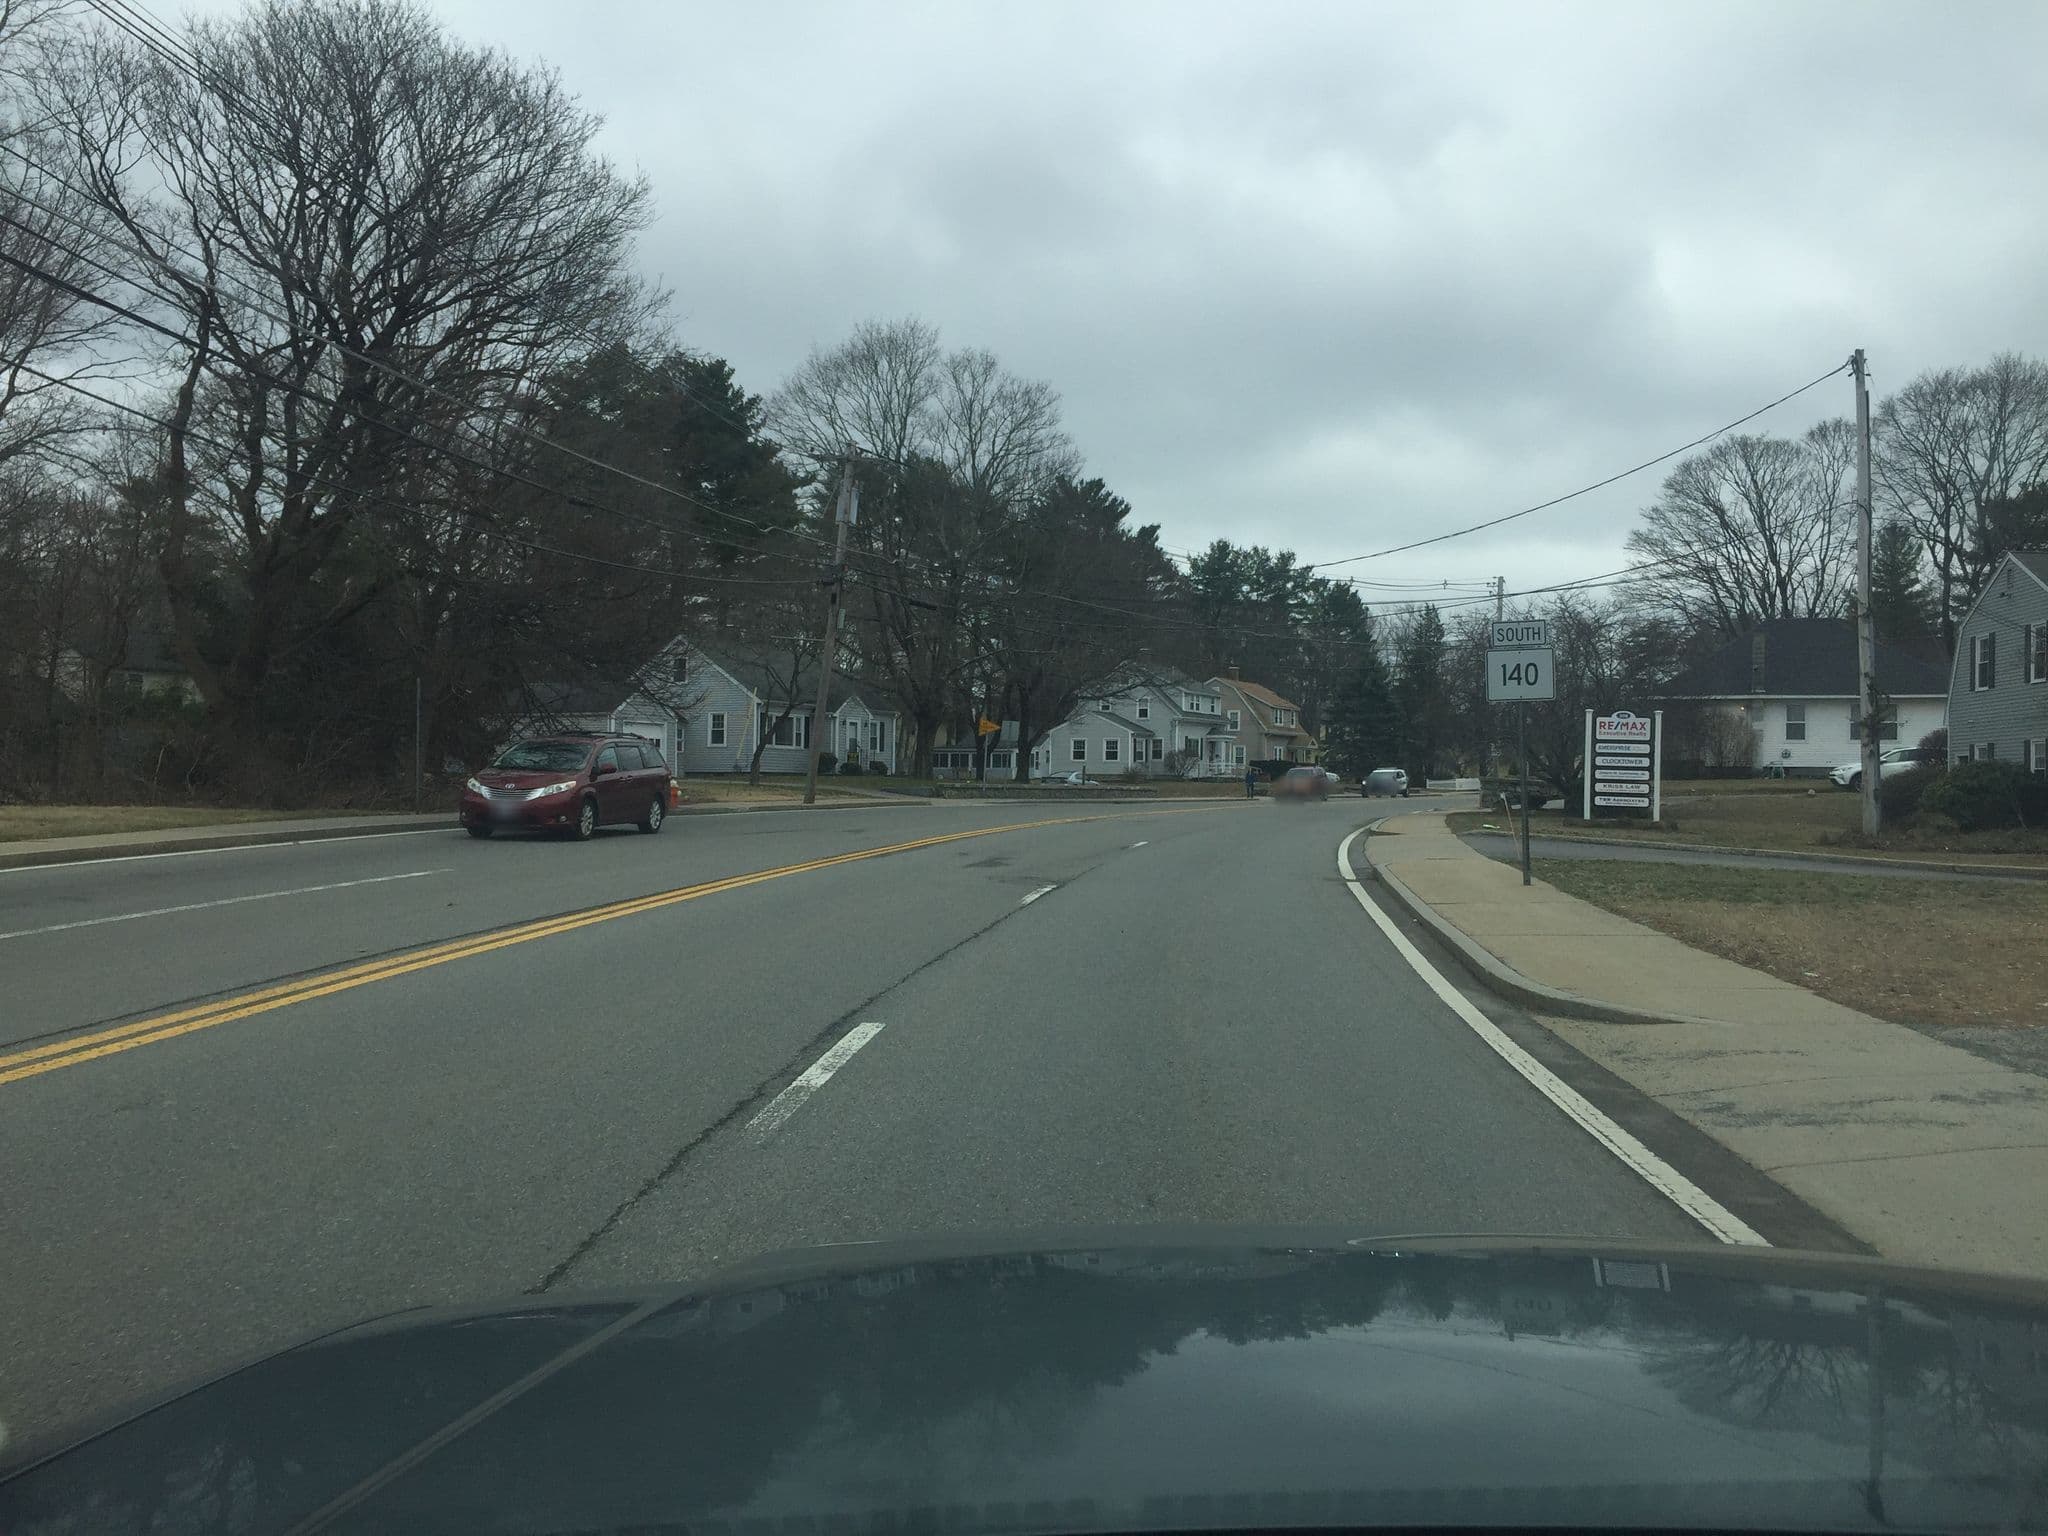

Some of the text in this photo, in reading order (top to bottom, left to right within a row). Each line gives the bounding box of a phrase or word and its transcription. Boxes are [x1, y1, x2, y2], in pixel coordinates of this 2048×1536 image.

[1496, 627, 1541, 642] SOUTH
[1501, 662, 1539, 686] 140
[1599, 721, 1647, 731] RE/MAX
